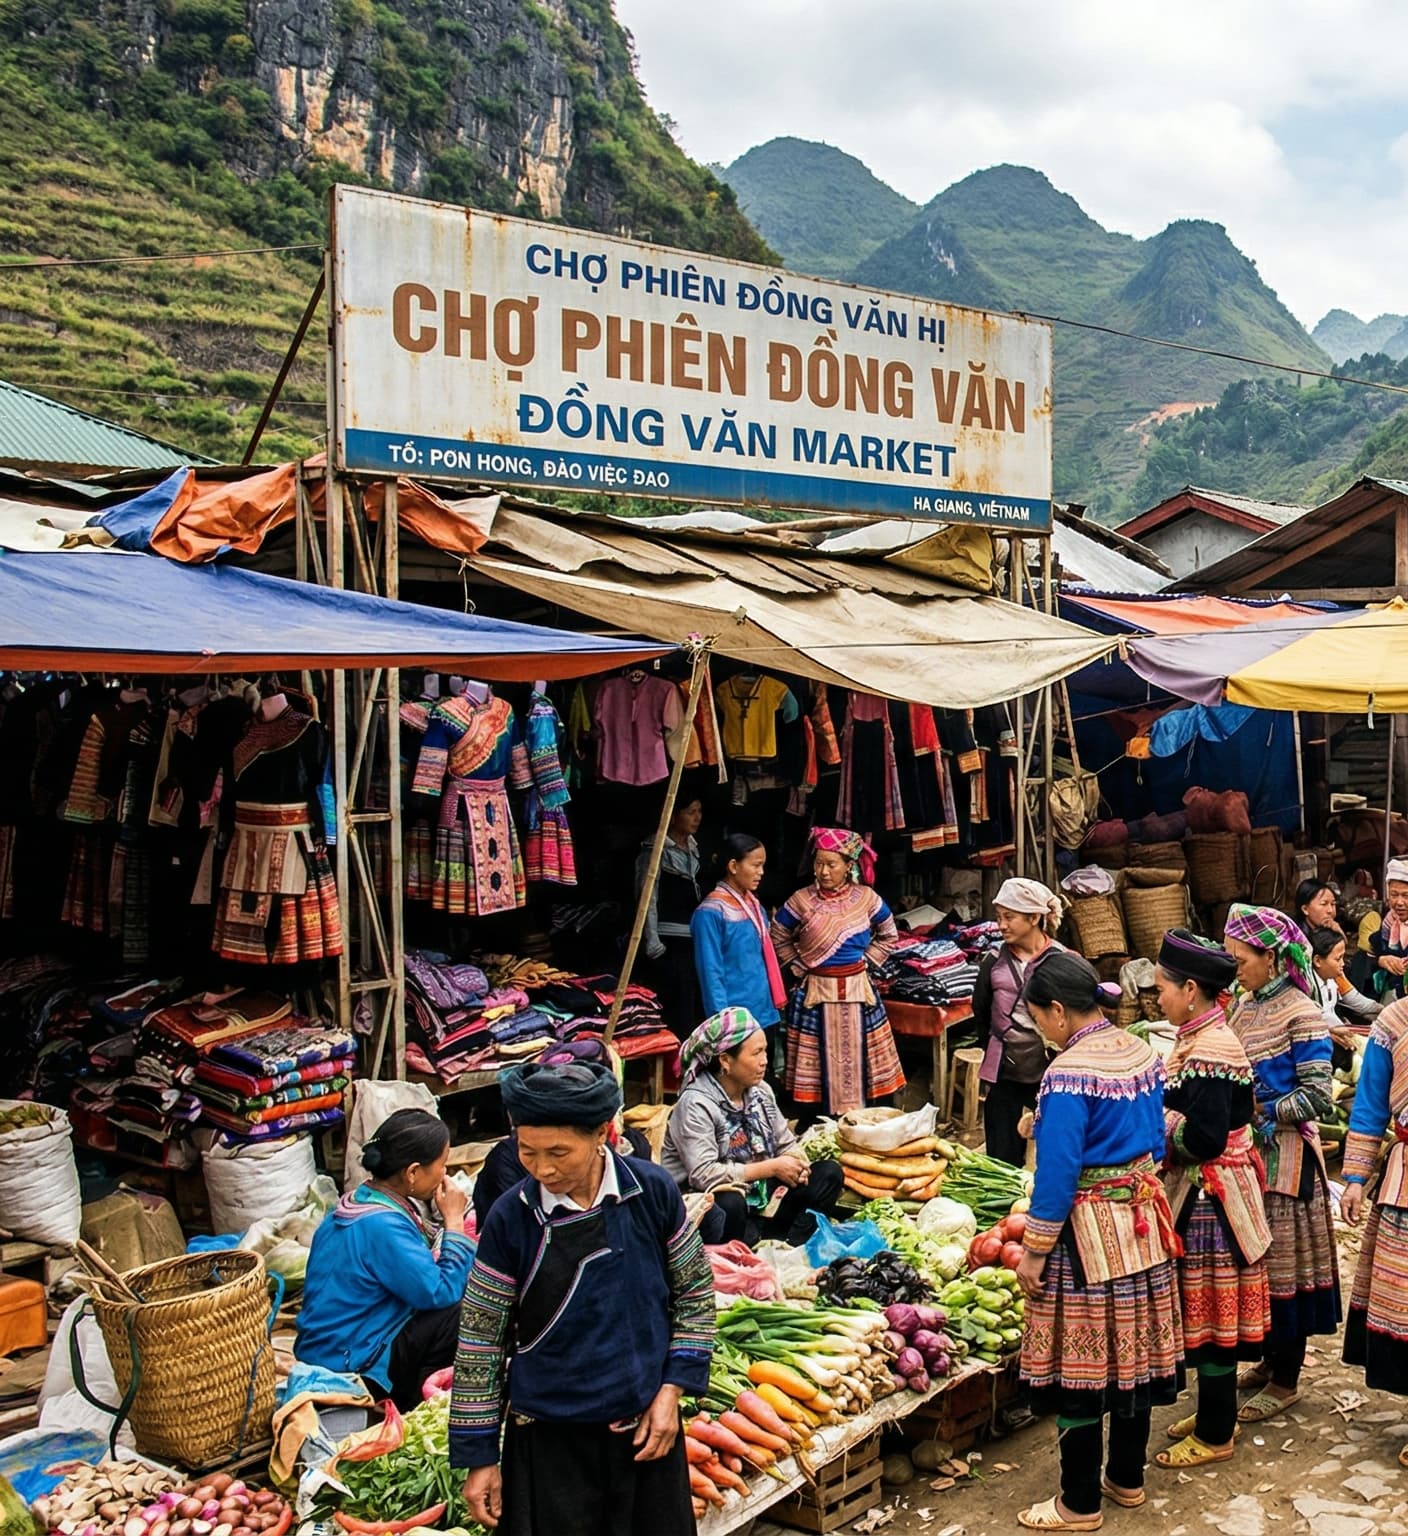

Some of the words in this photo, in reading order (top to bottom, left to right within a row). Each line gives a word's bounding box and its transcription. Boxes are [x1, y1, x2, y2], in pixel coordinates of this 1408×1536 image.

[526, 243, 607, 293] CHỢ
[621, 260, 726, 305] PHIÊN
[736, 275, 832, 324] ĐỒNG
[843, 298, 907, 338] VĂN
[918, 316, 946, 353] HỊ
[392, 282, 539, 382] CHỢ
[562, 308, 747, 396] PHIÊN
[766, 329, 914, 419] ĐỒNG
[931, 360, 1025, 434] VĂN
[477, 453, 537, 479] HONG,
[633, 469, 671, 488] ĐAO
[517, 382, 665, 447] ĐỒNG
[681, 408, 777, 459] VĂN
[792, 427, 957, 477] MARKET
[913, 496, 931, 511] HA
[934, 498, 976, 518] GIANG,
